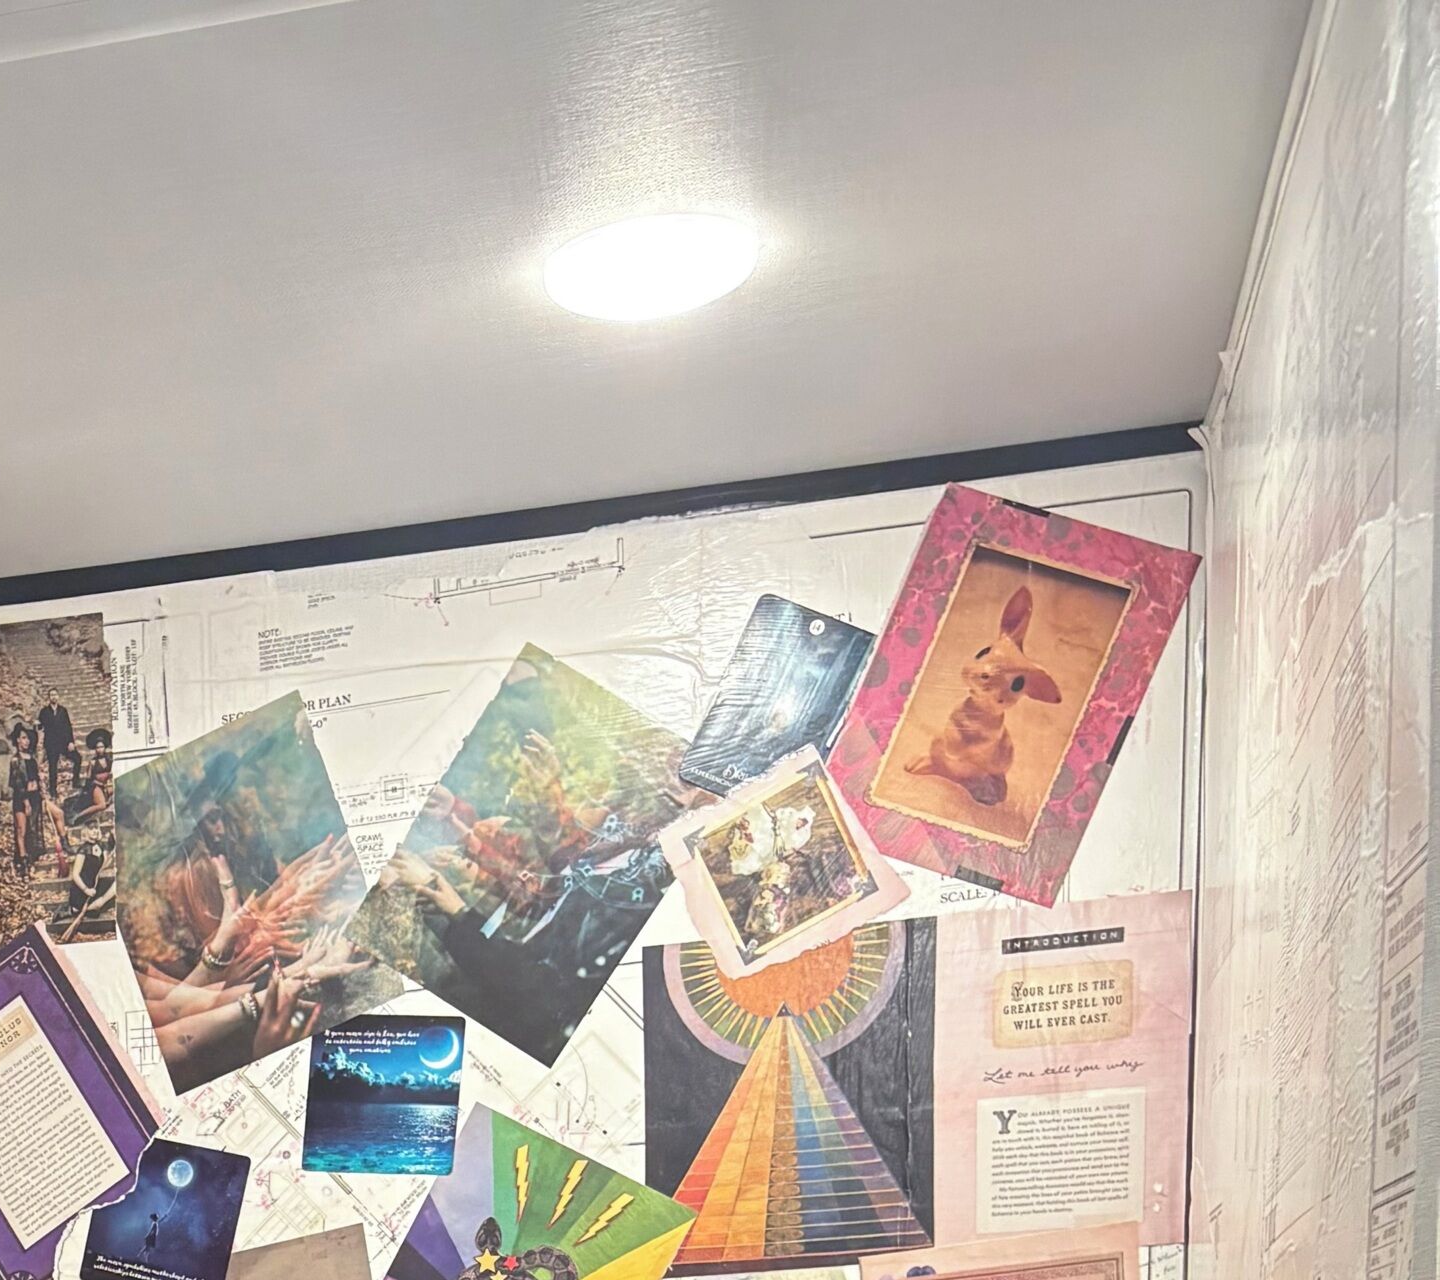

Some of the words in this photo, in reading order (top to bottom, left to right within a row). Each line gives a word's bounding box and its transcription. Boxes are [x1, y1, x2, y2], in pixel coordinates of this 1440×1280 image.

[318, 693, 352, 710] PLAN
[1006, 930, 1119, 950] INTRODUCTION
[1011, 981, 1044, 1002] YOUR
[1048, 983, 1074, 995] LIFE
[1078, 981, 1089, 993] IS
[1092, 979, 1116, 991] THE
[1003, 1000, 1059, 1015] GREATEST
[1061, 997, 1099, 1010] SPELL
[1102, 995, 1124, 1007] YOU
[1013, 1018, 1043, 1031] WILL
[1047, 1015, 1076, 1028] EVER
[1079, 1012, 1111, 1025] CAST.
[983, 1067, 1013, 1084] Let
[1041, 1065, 1071, 1076] tell
[1074, 1064, 1101, 1078] you
